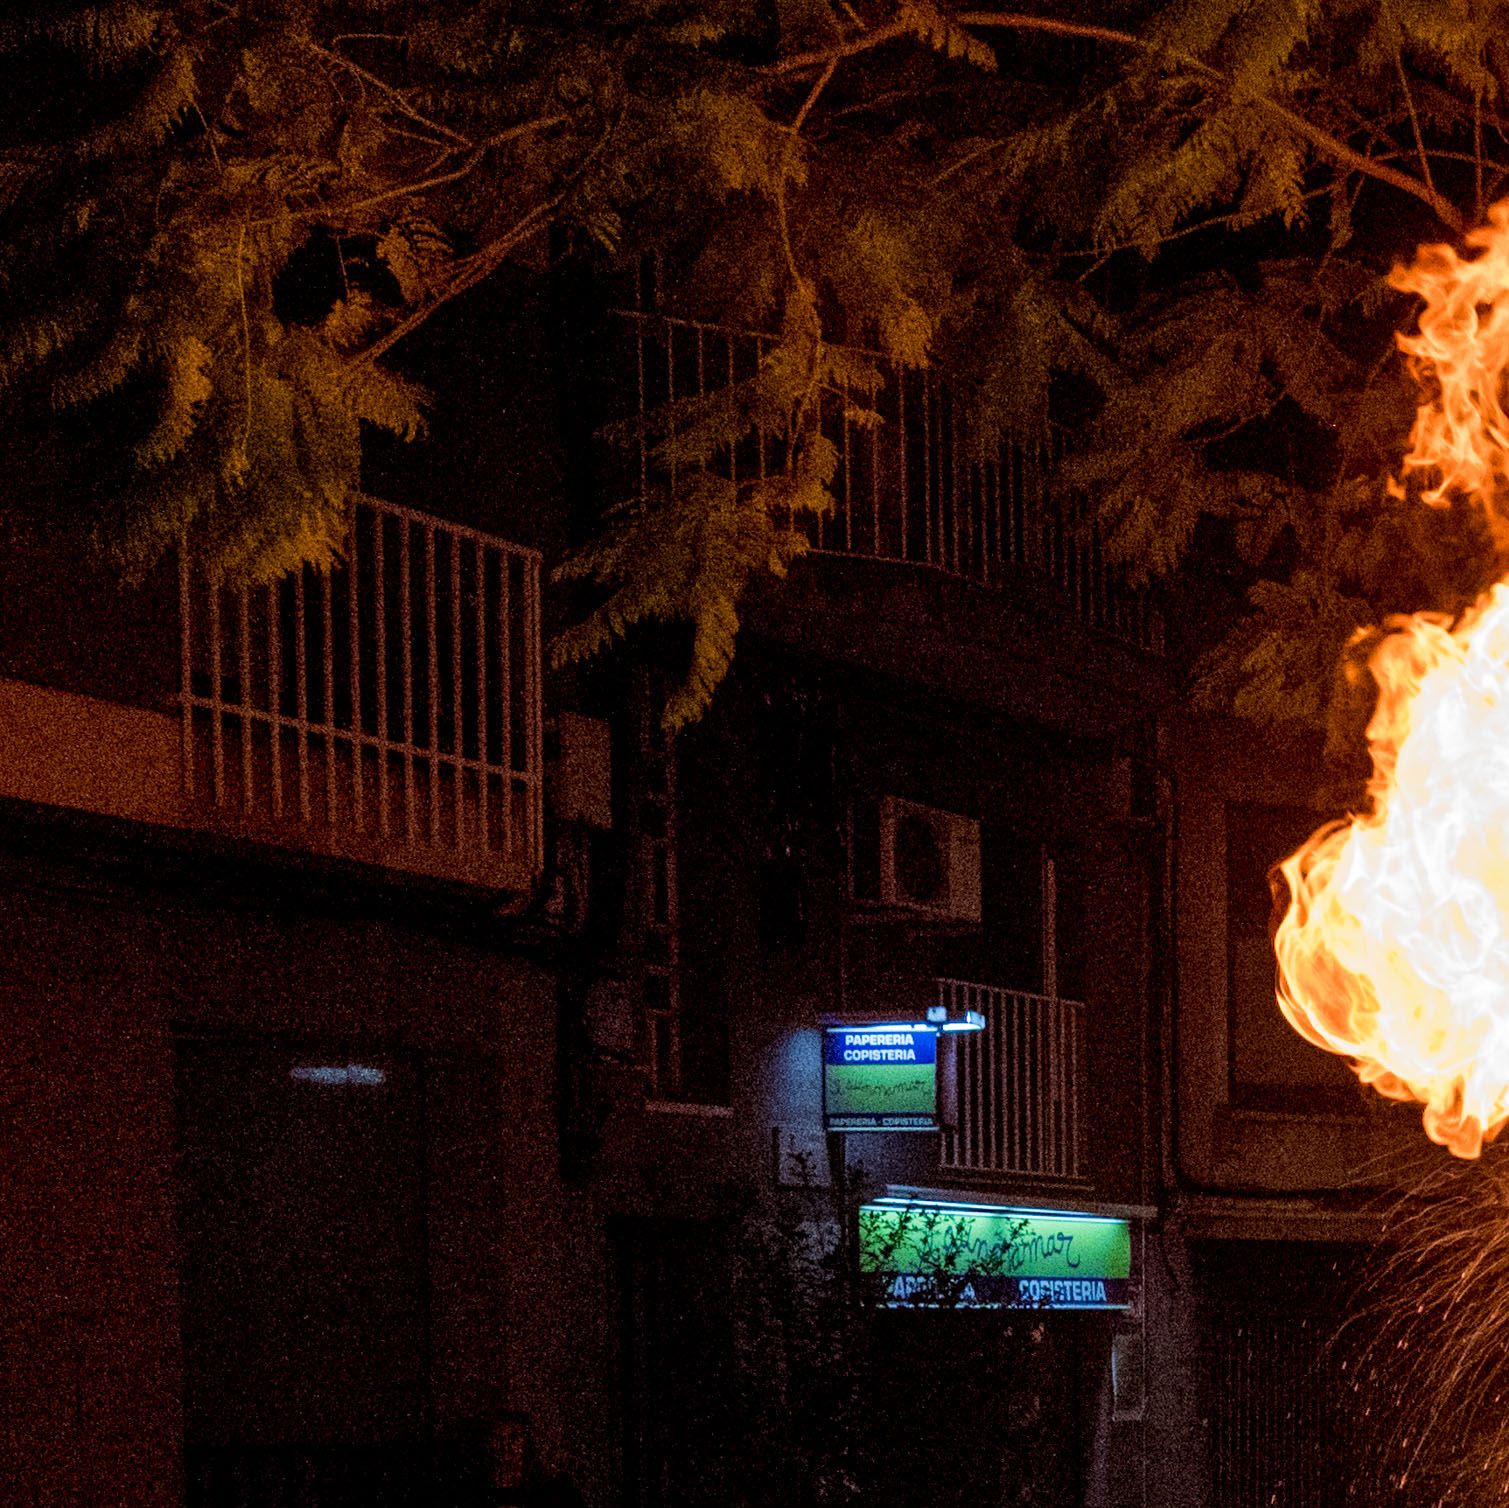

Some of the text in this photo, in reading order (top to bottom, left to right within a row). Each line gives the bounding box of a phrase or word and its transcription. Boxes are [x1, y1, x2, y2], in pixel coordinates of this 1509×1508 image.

[845, 1034, 914, 1046] PAPERERIA
[843, 1049, 916, 1061] COPISTERIA
[1019, 1279, 1107, 1302] COPISTERIA
